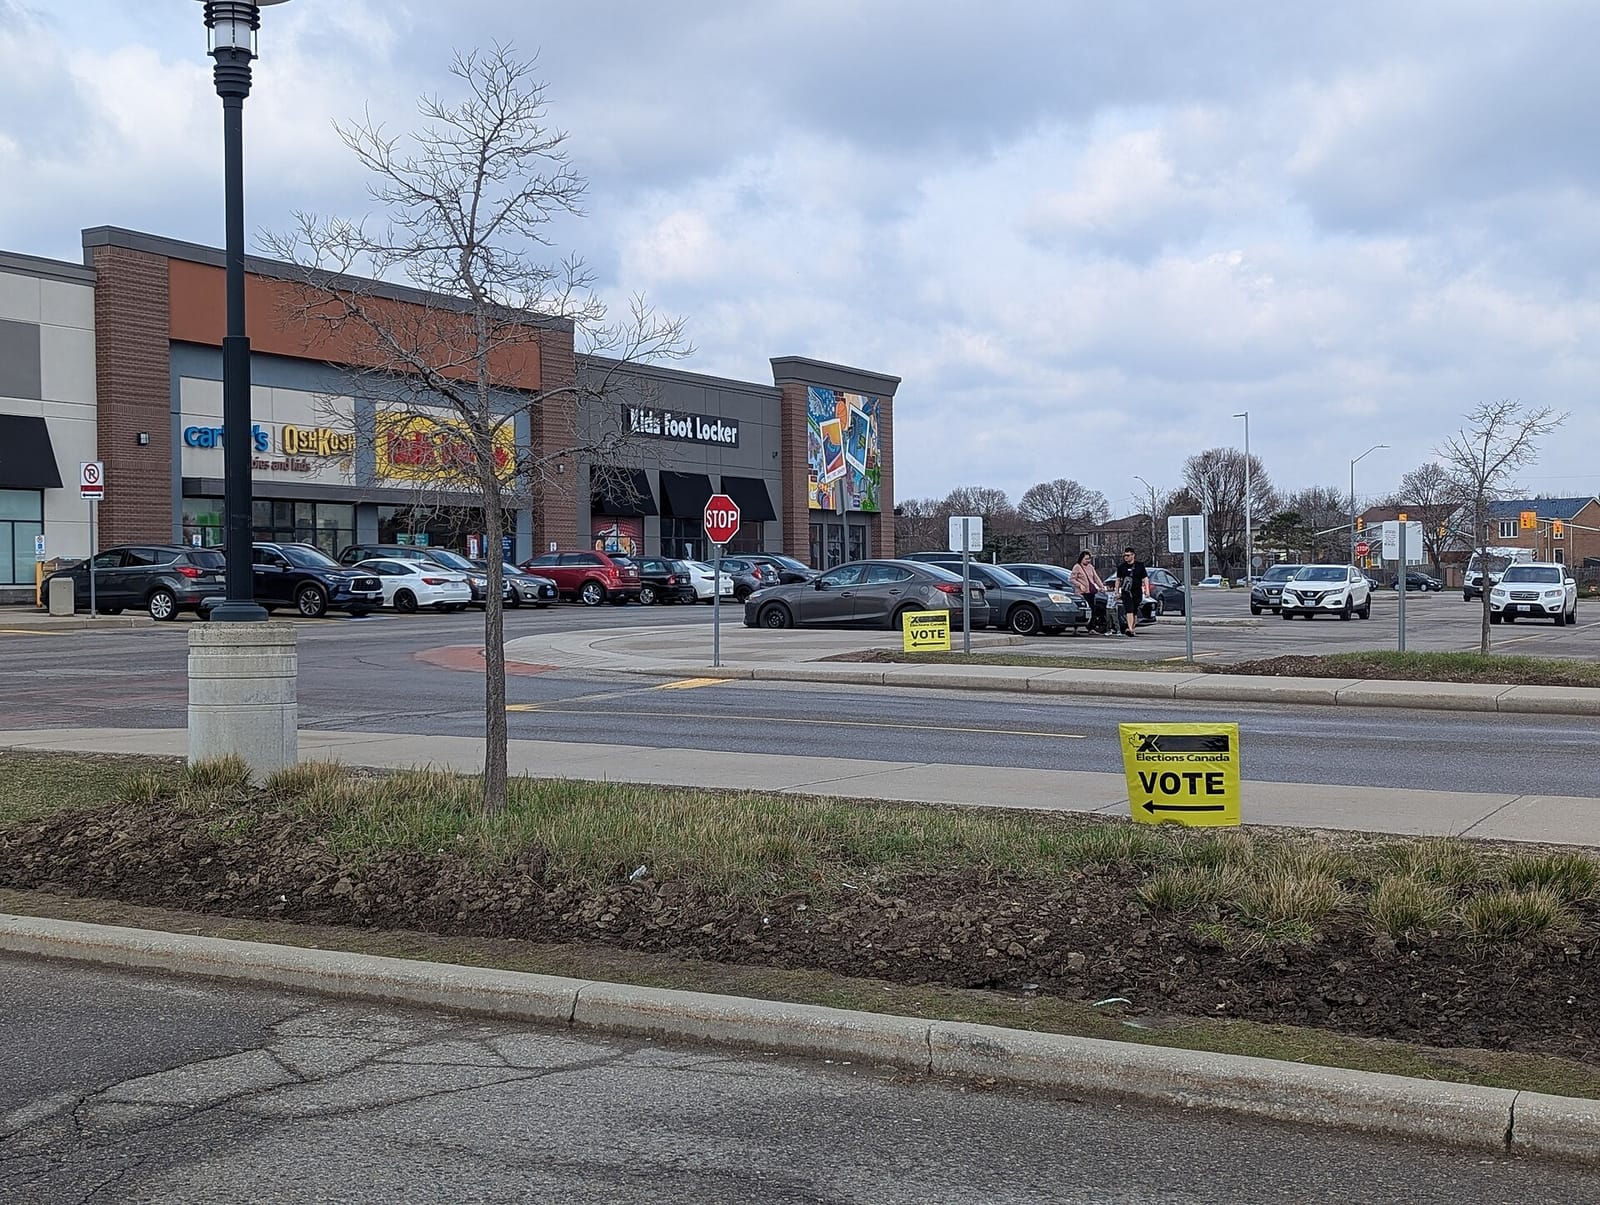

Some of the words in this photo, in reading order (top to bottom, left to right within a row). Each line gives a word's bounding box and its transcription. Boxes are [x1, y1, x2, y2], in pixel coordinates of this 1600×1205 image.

[630, 408, 660, 434] Kids
[664, 412, 693, 438] Foot
[696, 417, 737, 443] Locker
[184, 425, 269, 451] car's
[271, 458, 290, 471] and
[706, 510, 737, 528] STOP
[910, 629, 946, 640] VOTE
[1136, 753, 1185, 762] Elections
[1186, 753, 1230, 762] Canada
[1138, 771, 1225, 795] VOTE
